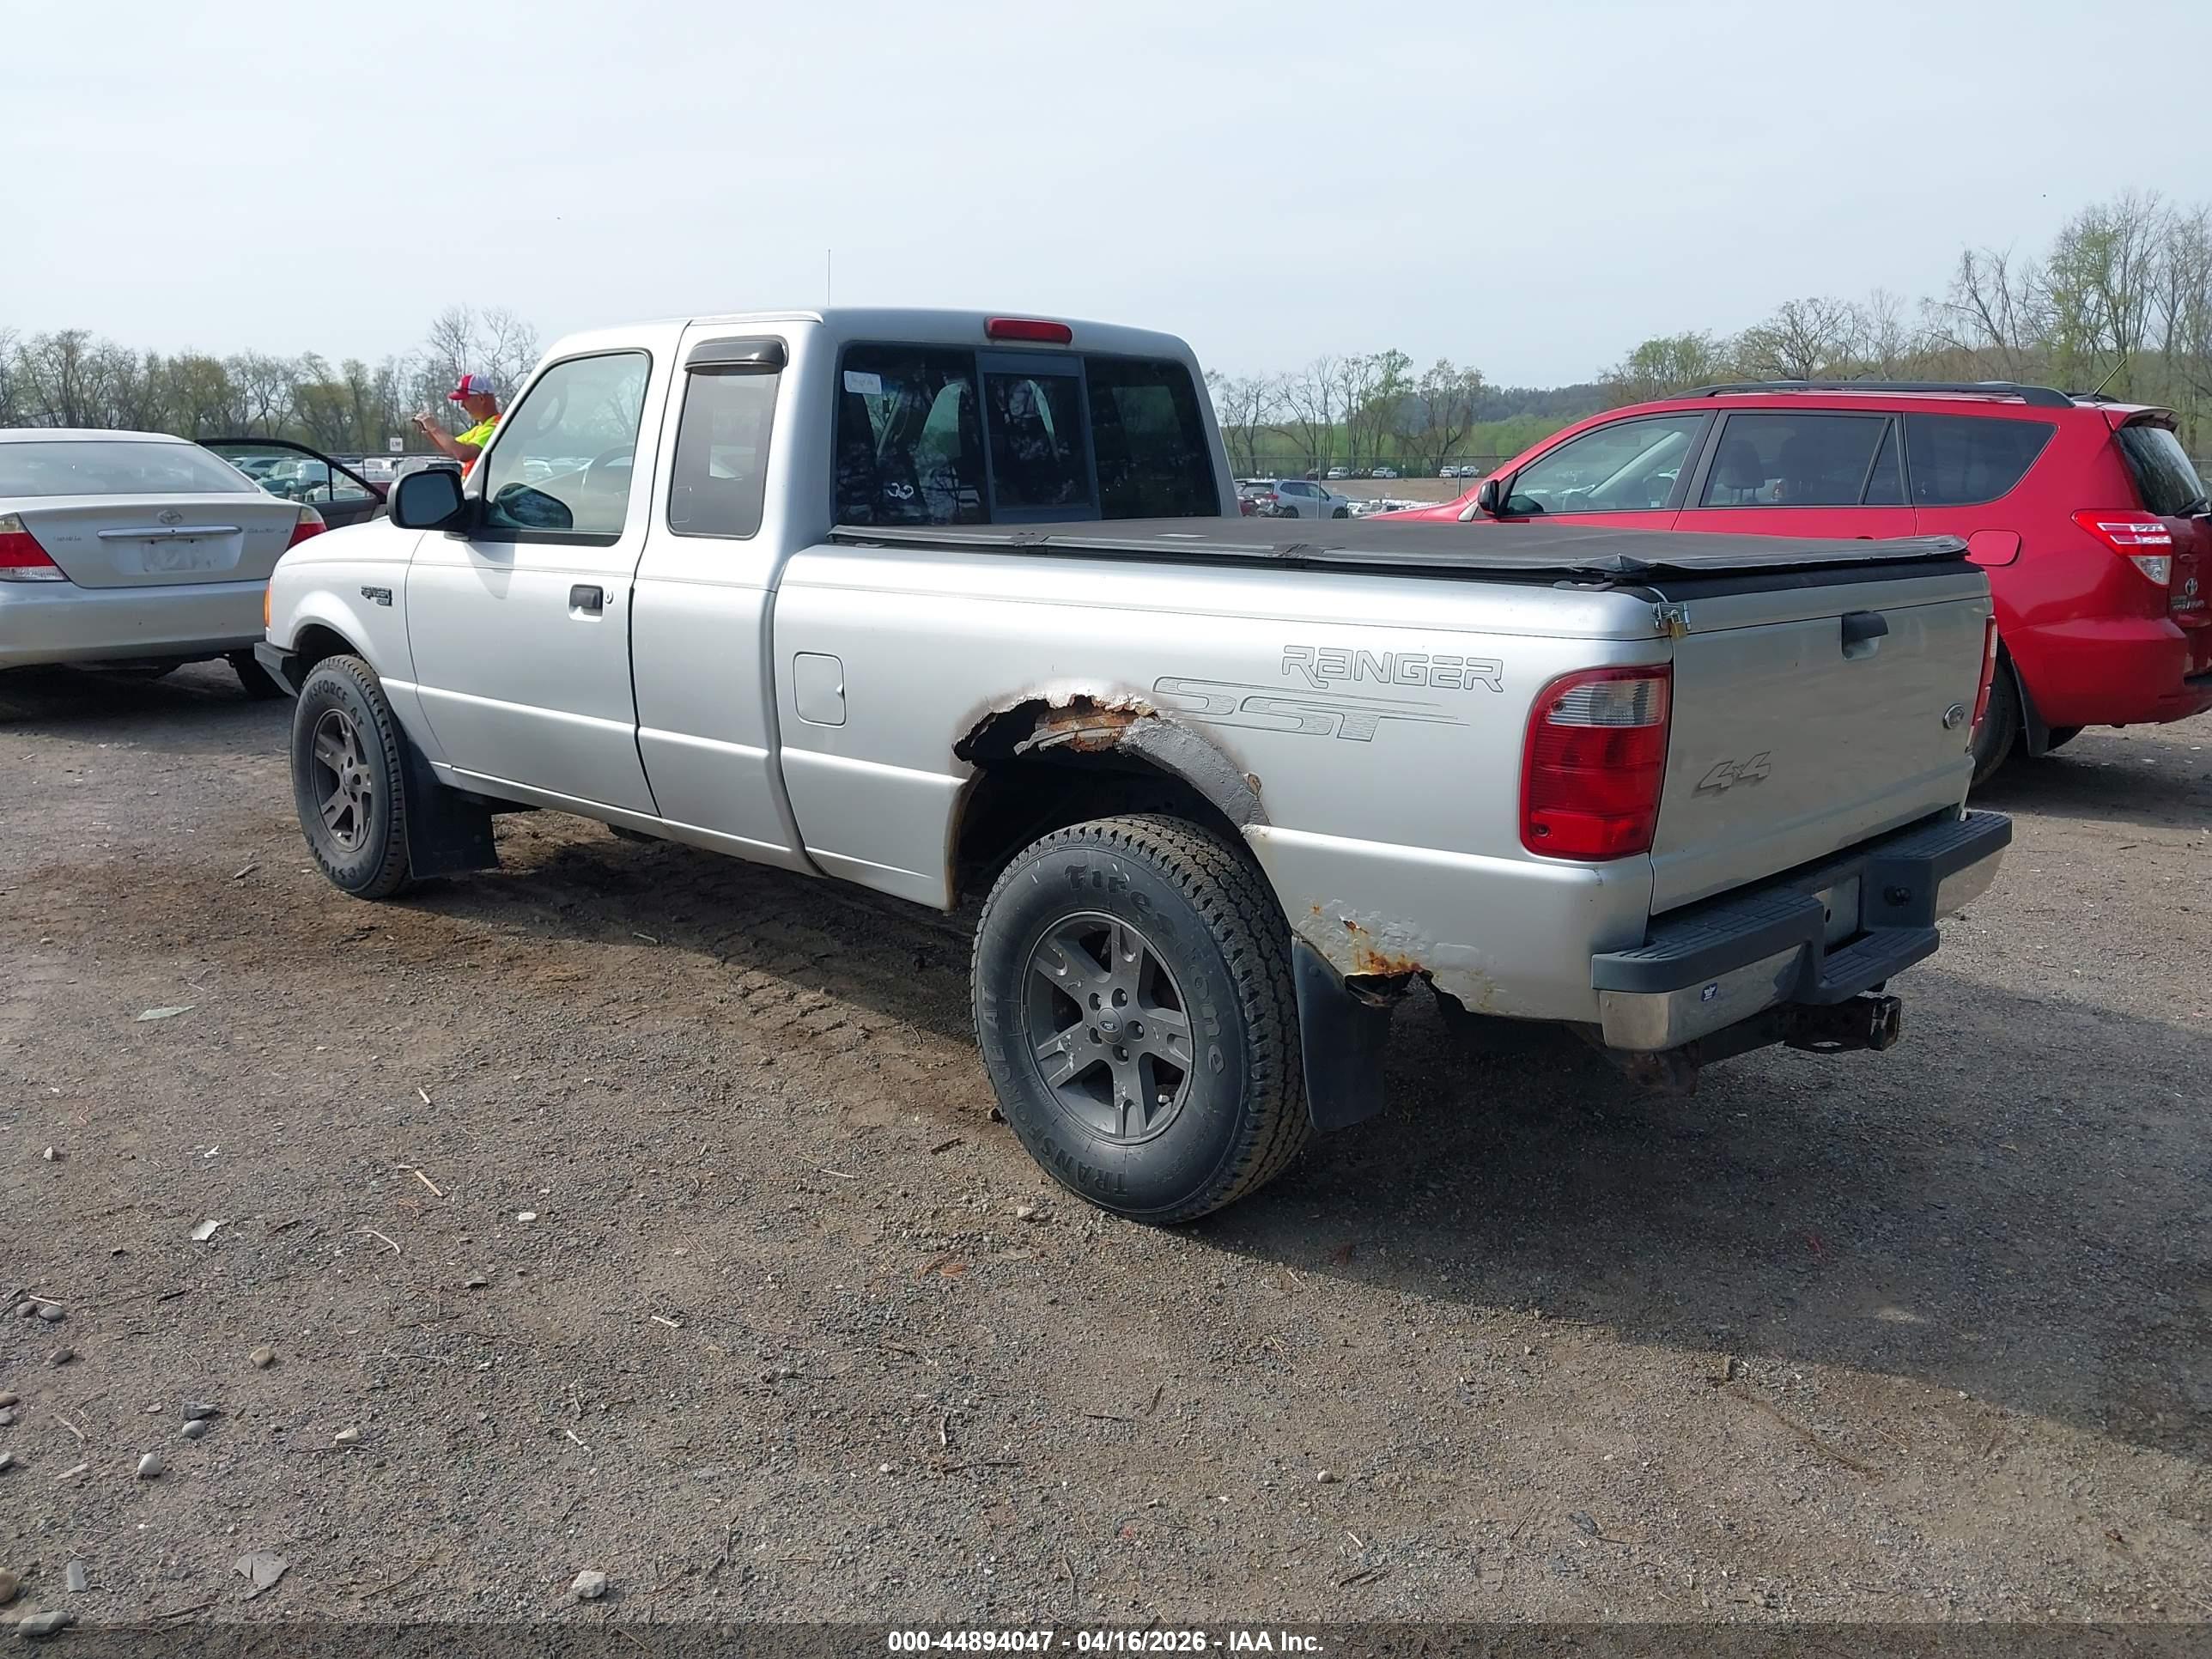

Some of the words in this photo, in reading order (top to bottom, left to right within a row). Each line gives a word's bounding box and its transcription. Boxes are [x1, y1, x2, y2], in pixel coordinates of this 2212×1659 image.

[1282, 645, 1504, 693] RANGER
[1152, 677, 1430, 742] SST
[988, 1046, 1128, 1197] TRANSFORCE
